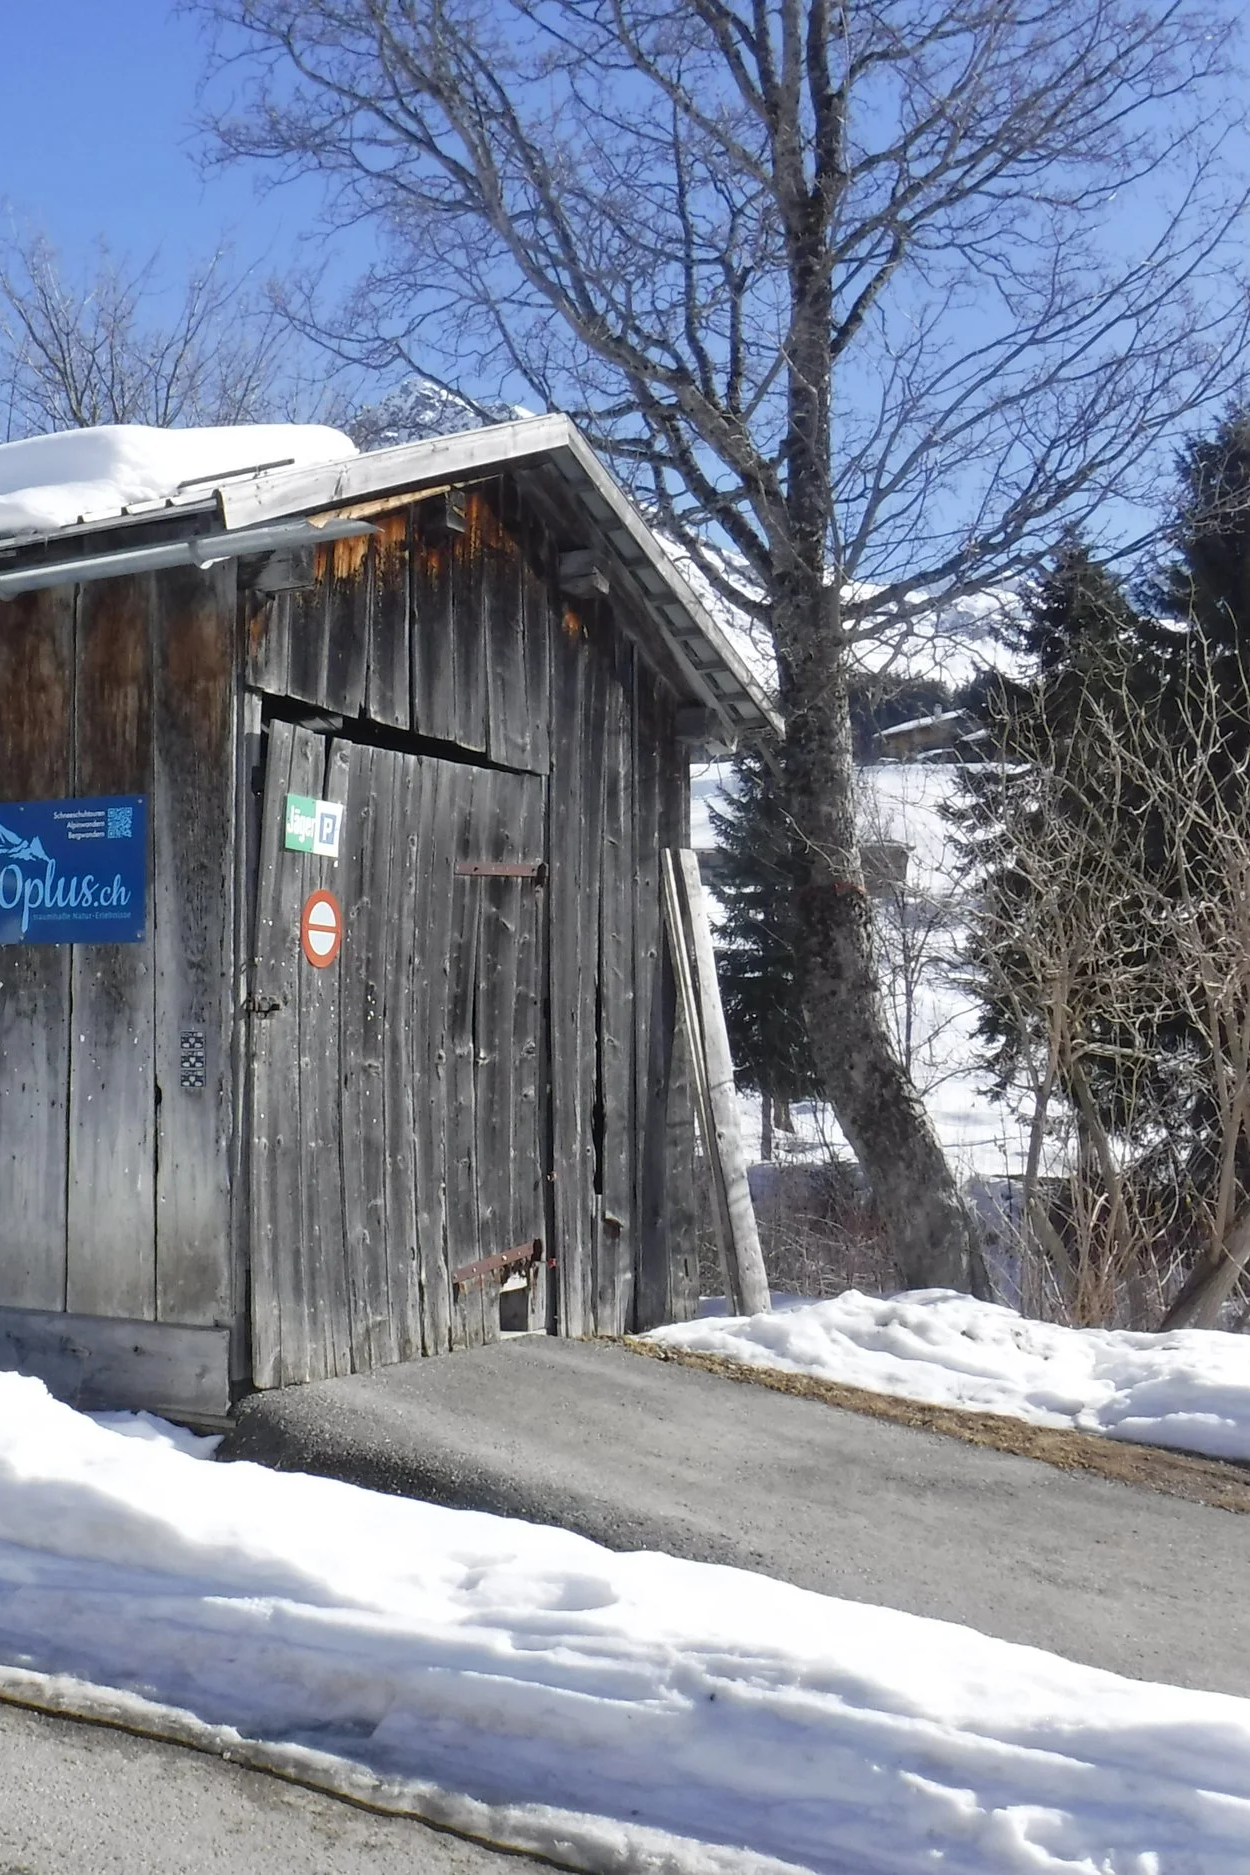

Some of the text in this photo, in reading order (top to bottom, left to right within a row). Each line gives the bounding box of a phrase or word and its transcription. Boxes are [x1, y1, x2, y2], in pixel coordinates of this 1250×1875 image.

[53, 809, 105, 820] Schneeschuhtouren
[66, 820, 105, 830] Alpinwandern
[286, 804, 333, 844] Jäger P
[67, 830, 105, 840] Bergwandern
